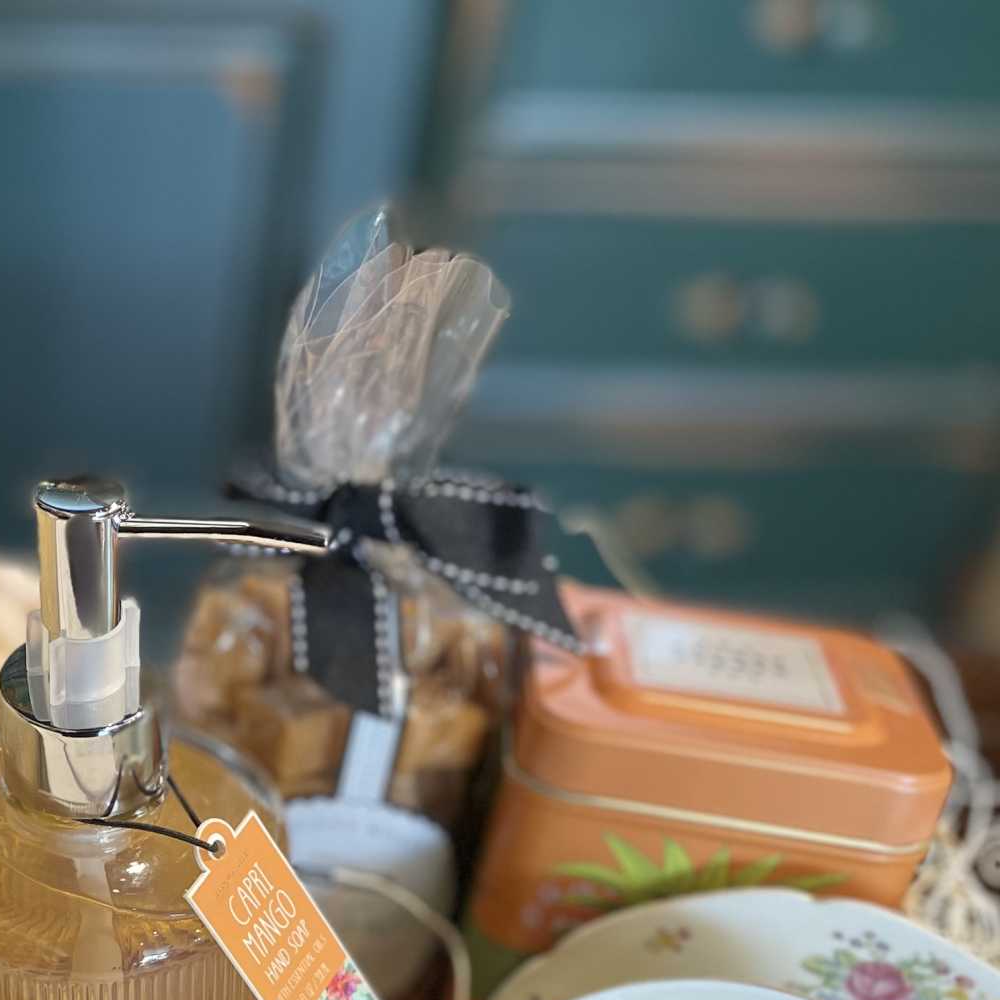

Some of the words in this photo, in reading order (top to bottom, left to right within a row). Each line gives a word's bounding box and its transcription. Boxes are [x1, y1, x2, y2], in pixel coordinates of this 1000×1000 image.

[229, 862, 274, 925] CAPRI
[242, 889, 296, 965] MANGO
[264, 948, 290, 984] HAND
[287, 919, 310, 953] SOAP
